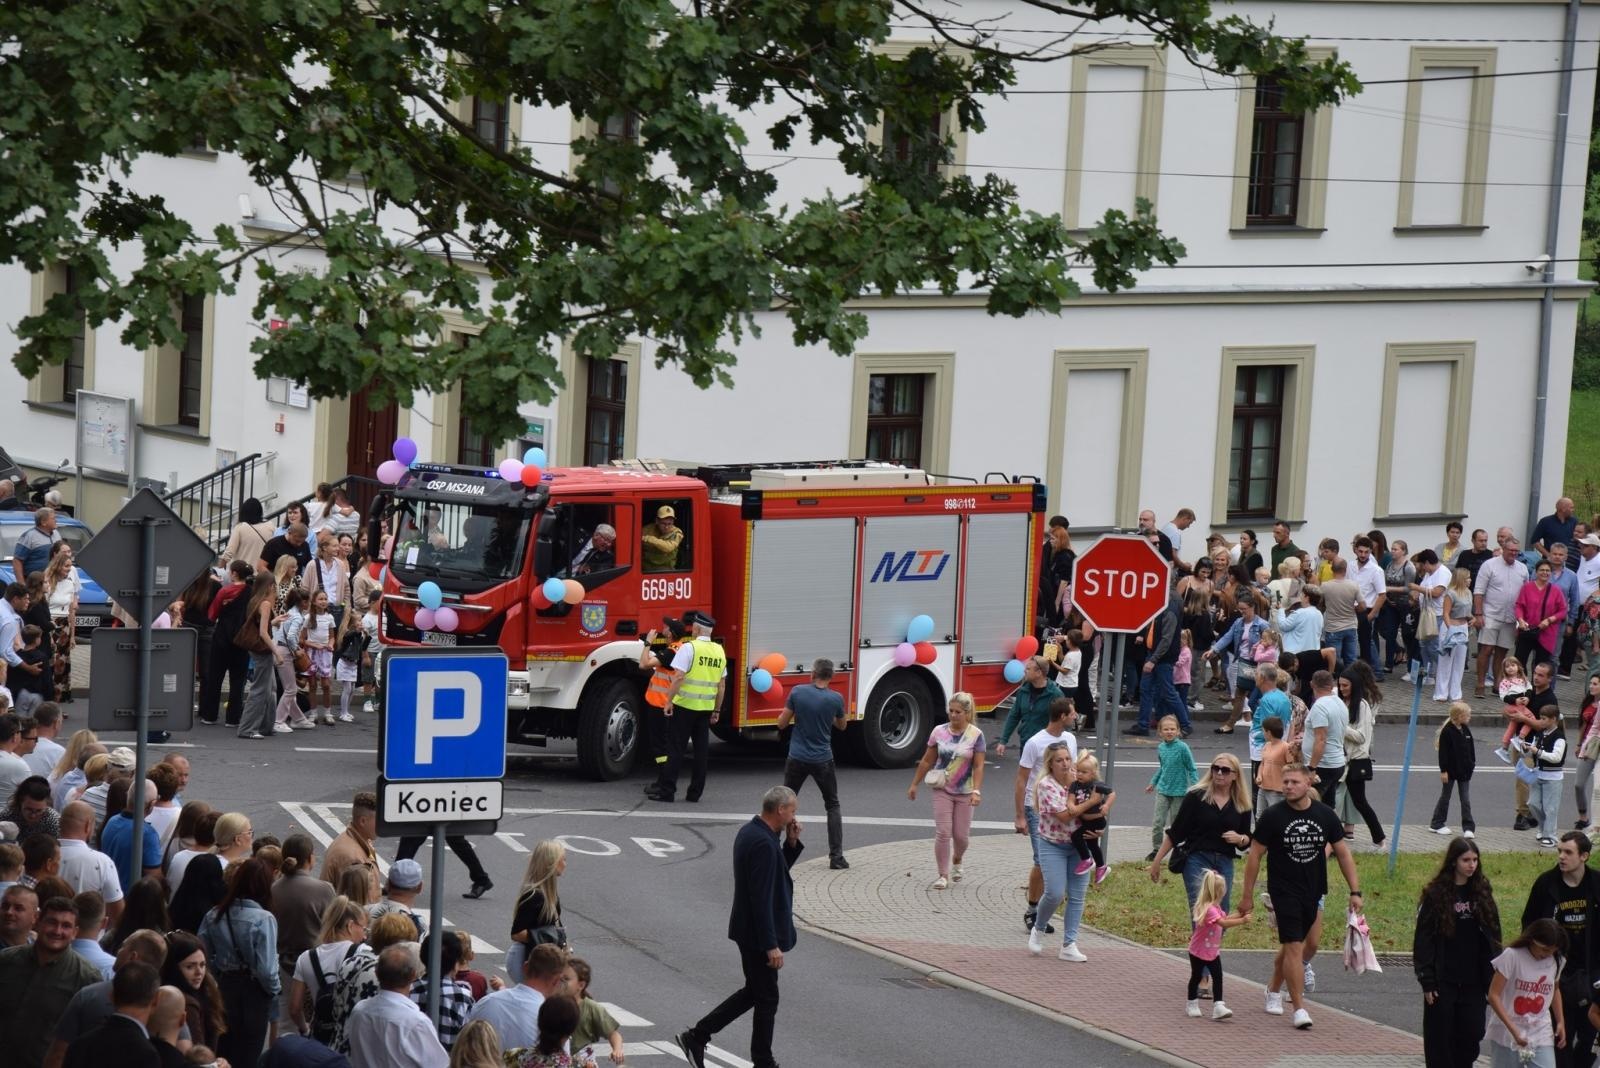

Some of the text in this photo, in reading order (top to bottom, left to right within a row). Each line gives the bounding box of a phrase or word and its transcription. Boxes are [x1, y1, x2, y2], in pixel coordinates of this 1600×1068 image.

[427, 480, 485, 495] OSP MSZANA
[944, 497, 976, 510] 998 112
[1083, 568, 1160, 600] STOP
[414, 670, 482, 764] P
[398, 790, 488, 814] Koniec
